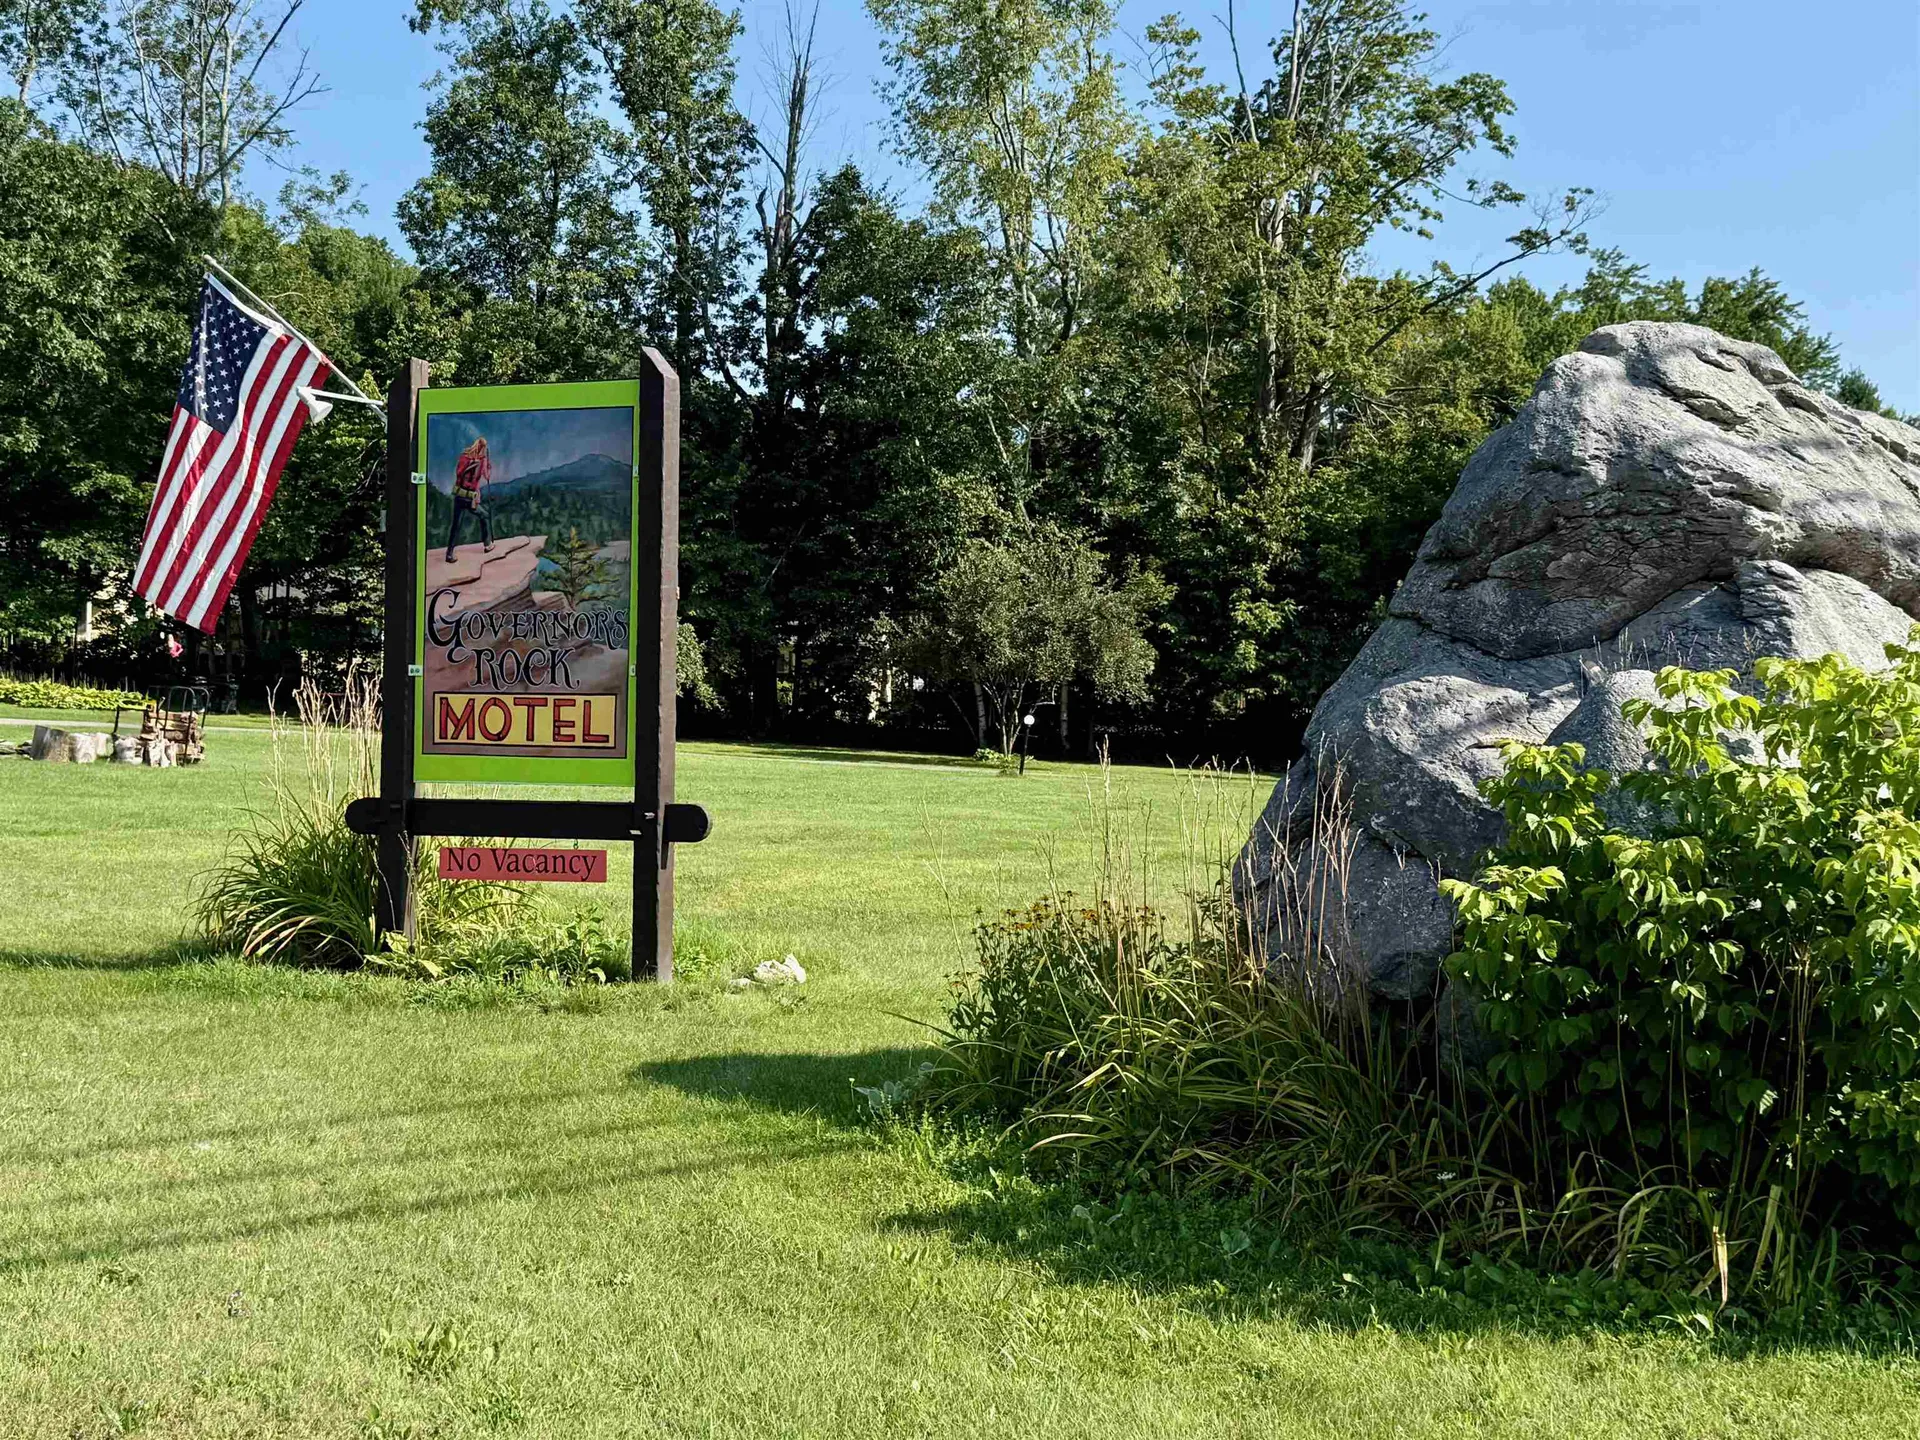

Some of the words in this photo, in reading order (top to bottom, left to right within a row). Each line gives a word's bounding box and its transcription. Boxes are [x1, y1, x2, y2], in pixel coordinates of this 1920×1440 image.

[469, 648, 580, 690] ROCK
[439, 696, 610, 743] MOTEL
[447, 847, 481, 872] No
[490, 848, 597, 882] Vacancy
